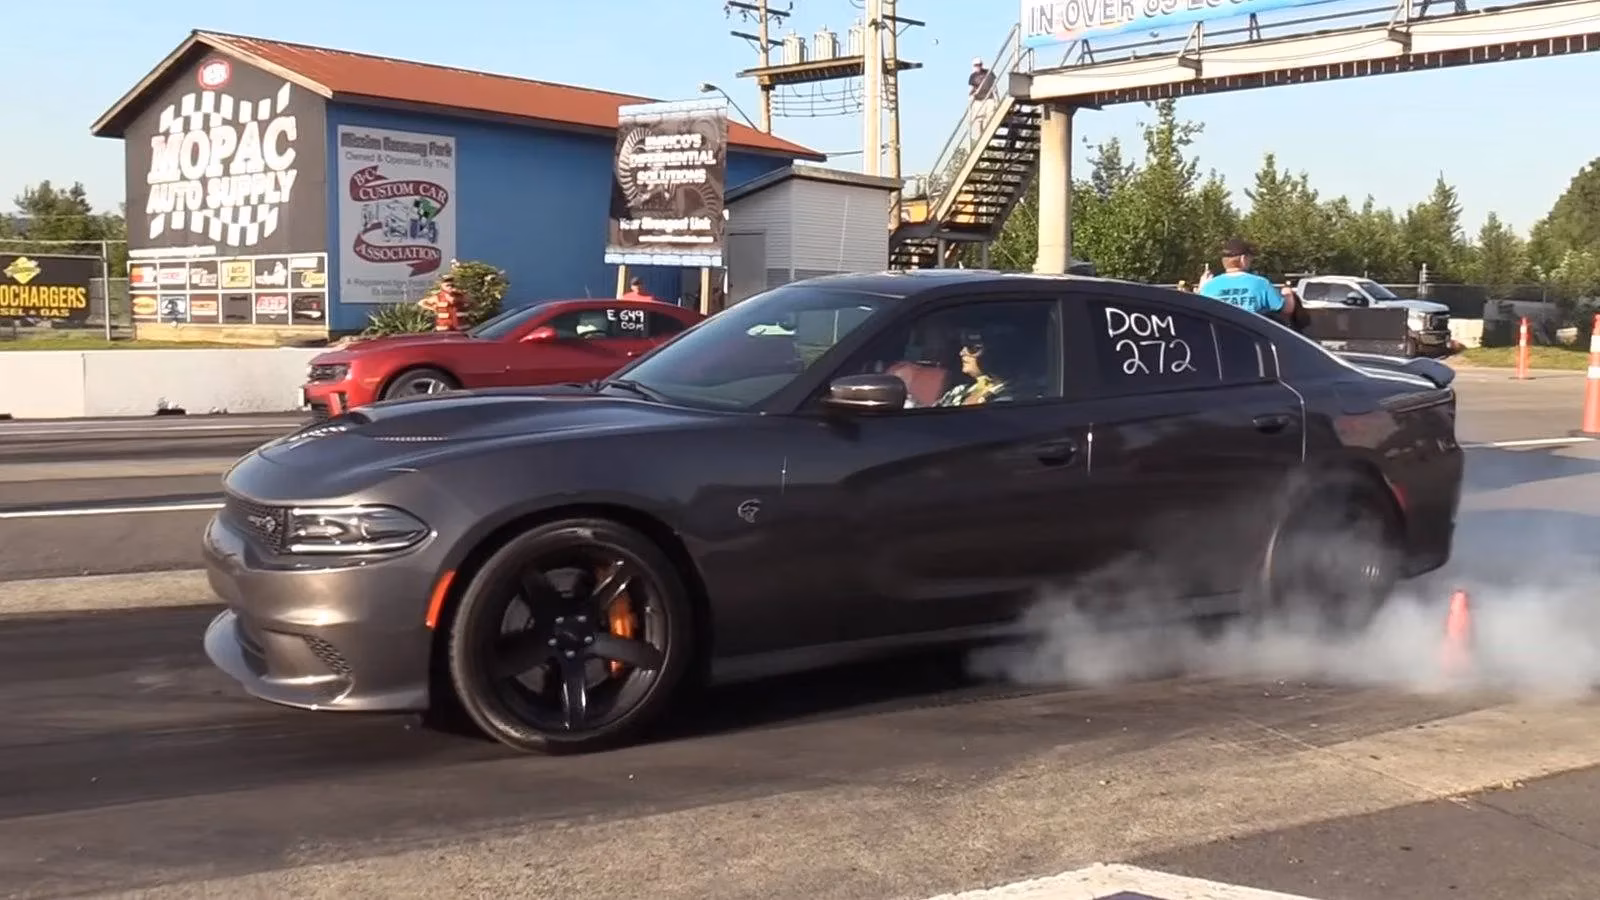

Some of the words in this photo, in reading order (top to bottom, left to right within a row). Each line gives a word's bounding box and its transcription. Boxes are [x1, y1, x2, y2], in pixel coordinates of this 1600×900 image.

[1028, 3, 1055, 37] IN
[1063, 0, 1135, 31] OVER
[147, 115, 297, 184] MOPAC
[429, 141, 453, 158] Park
[146, 180, 204, 214] AUTO
[206, 169, 298, 209] SUPPLY
[359, 182, 414, 200] CUSTOM
[419, 184, 447, 204] CAR
[355, 243, 439, 260] ASSOCIATION
[606, 309, 617, 321] E
[619, 309, 645, 323] 649
[1105, 307, 1176, 338] DOM
[1116, 339, 1197, 375] 272
